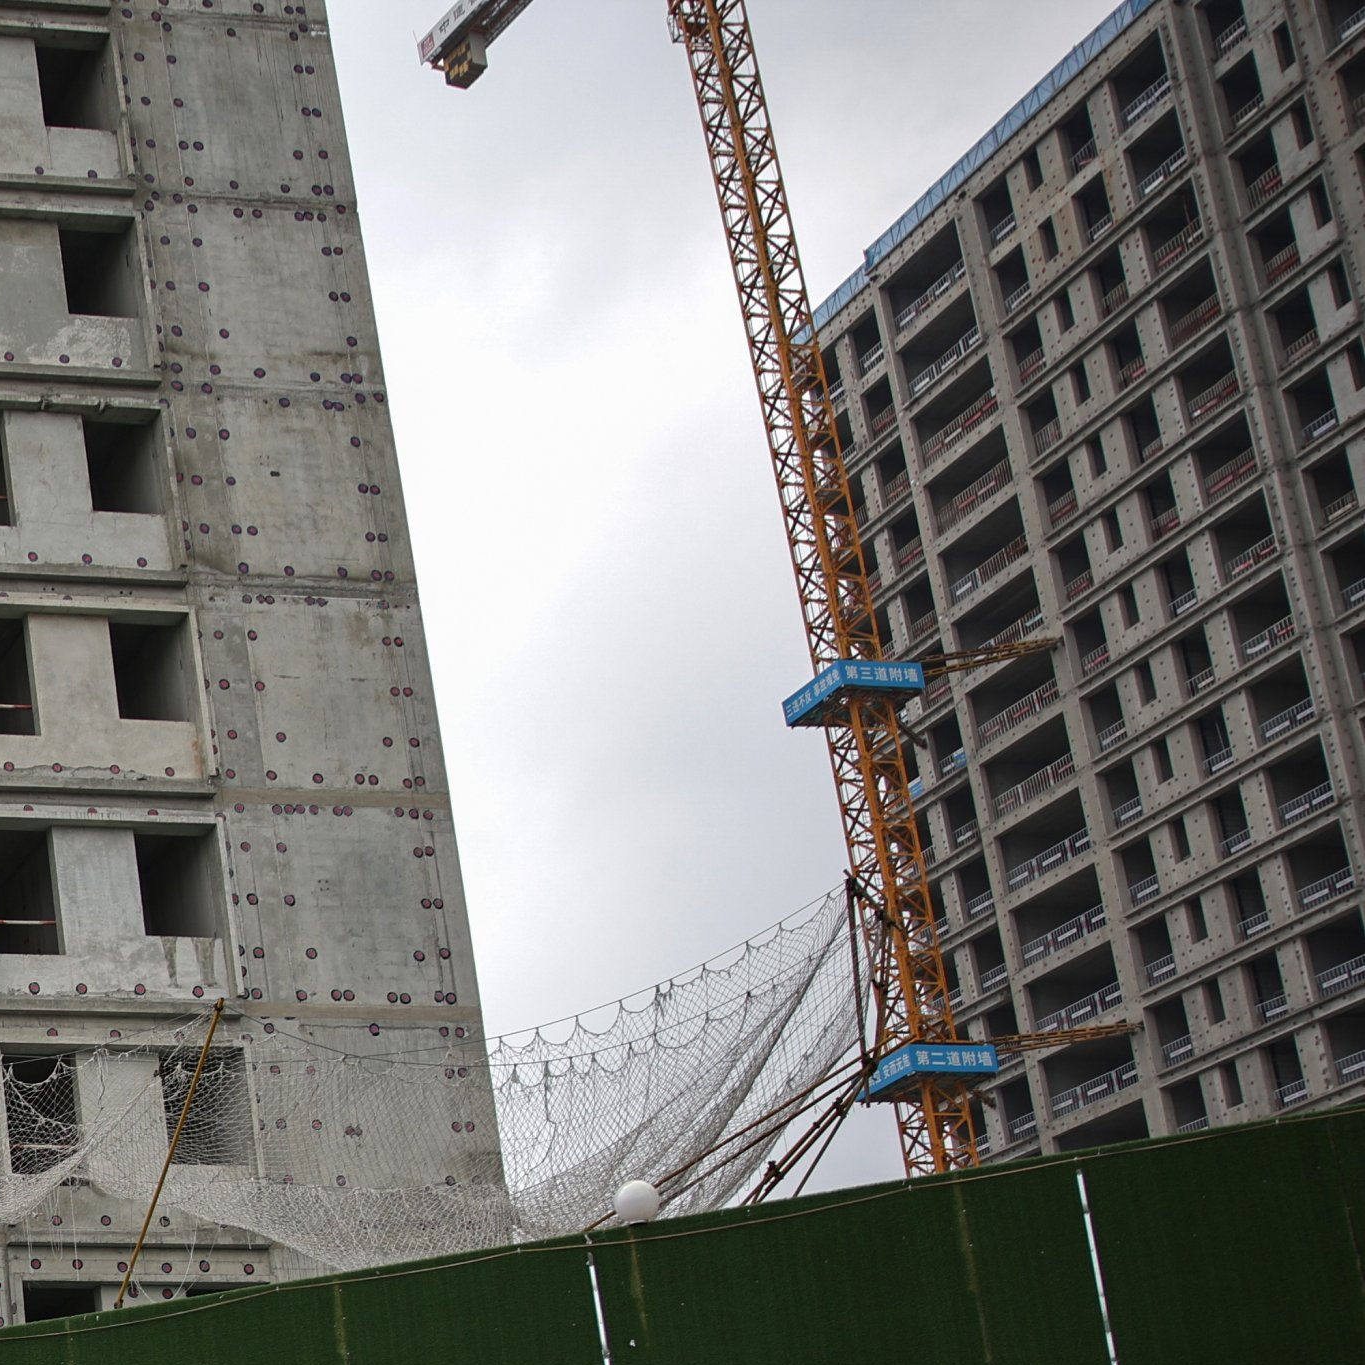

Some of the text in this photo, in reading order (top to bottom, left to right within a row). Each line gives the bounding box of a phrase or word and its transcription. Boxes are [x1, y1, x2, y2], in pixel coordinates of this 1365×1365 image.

[845, 665, 918, 682] 第三道附墙
[915, 1050, 992, 1067] 第二道附墙
